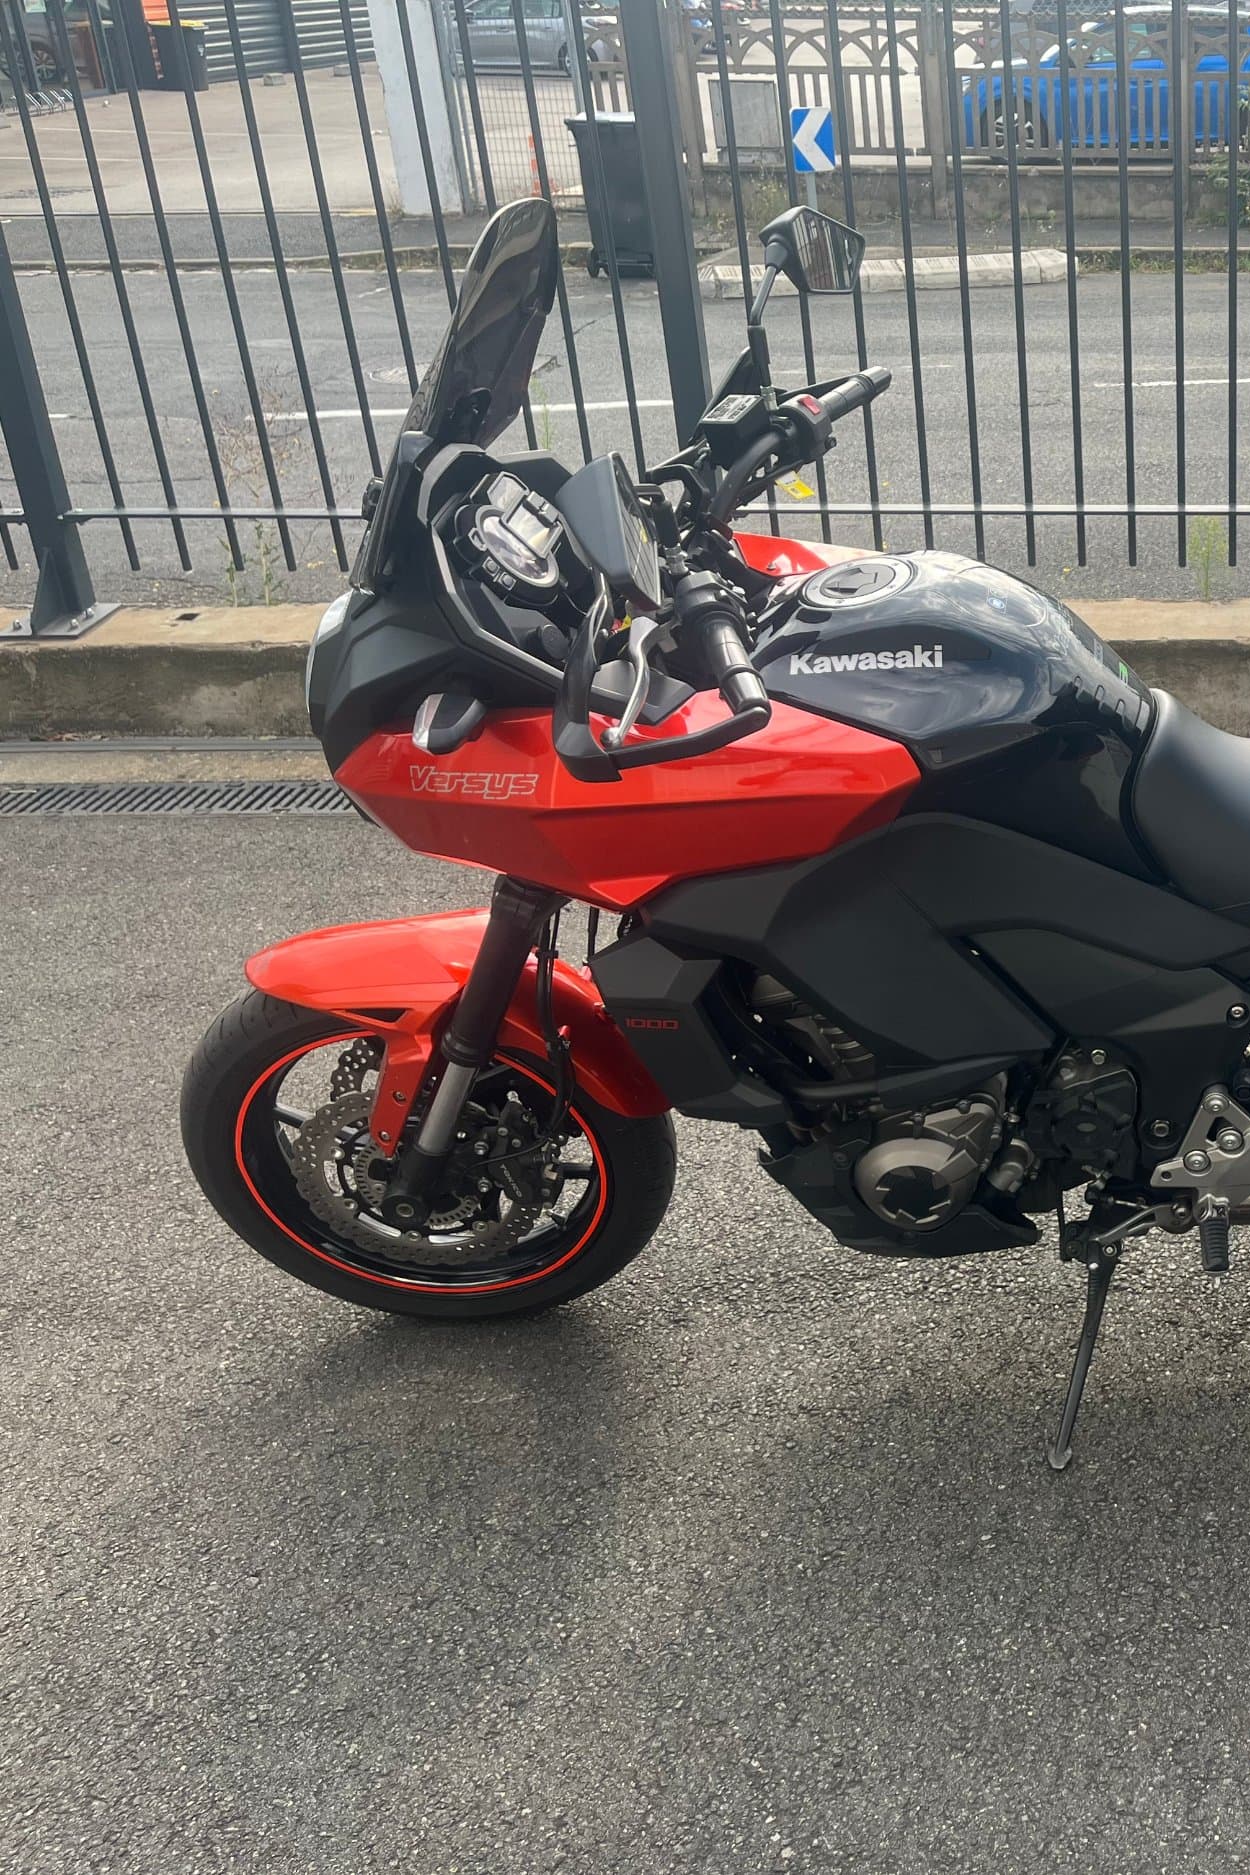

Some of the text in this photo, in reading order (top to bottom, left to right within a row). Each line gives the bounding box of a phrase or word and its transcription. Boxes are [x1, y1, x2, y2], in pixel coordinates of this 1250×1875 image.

[789, 644, 943, 675] Kawasaki
[409, 765, 539, 800] Versys
[625, 1017, 679, 1030] 1000
